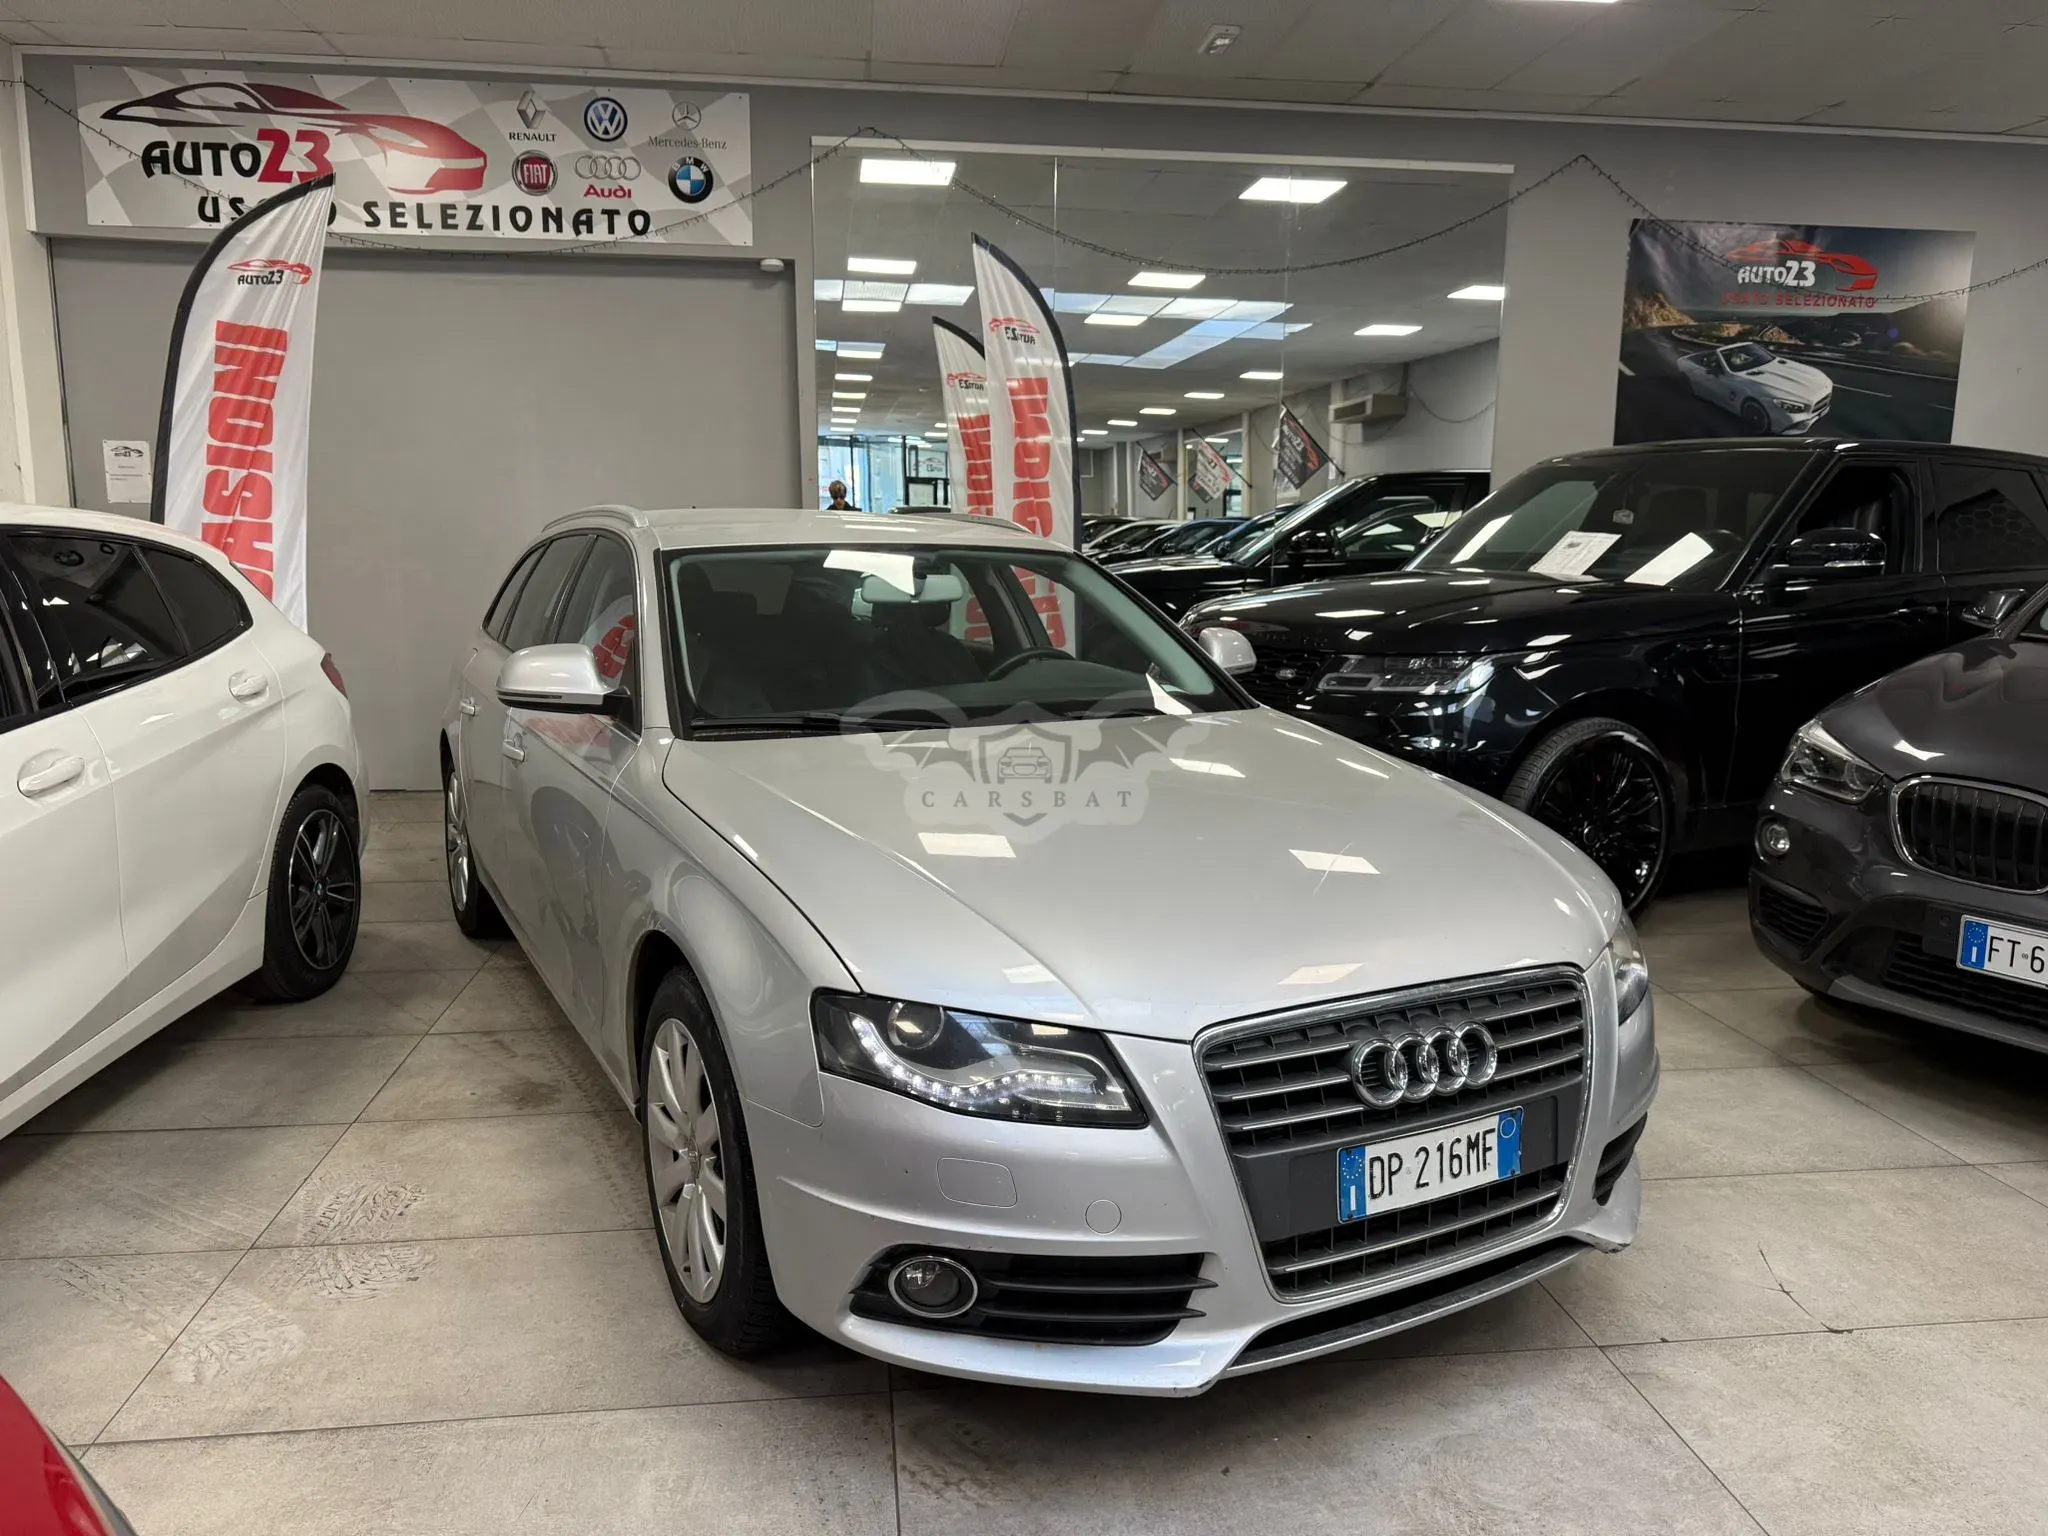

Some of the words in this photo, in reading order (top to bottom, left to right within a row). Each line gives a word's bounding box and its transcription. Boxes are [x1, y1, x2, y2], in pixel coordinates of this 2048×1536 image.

[508, 132, 556, 142] RENAULT
[648, 136, 728, 150] Mercedes-Benz
[523, 163, 548, 185] FIAT
[583, 184, 632, 199] Audi
[363, 200, 651, 237] SELEZIONATO
[237, 270, 285, 286] AUTO23
[1738, 260, 1816, 287] AUTO23
[1775, 292, 1876, 308] SELEZIONATO
